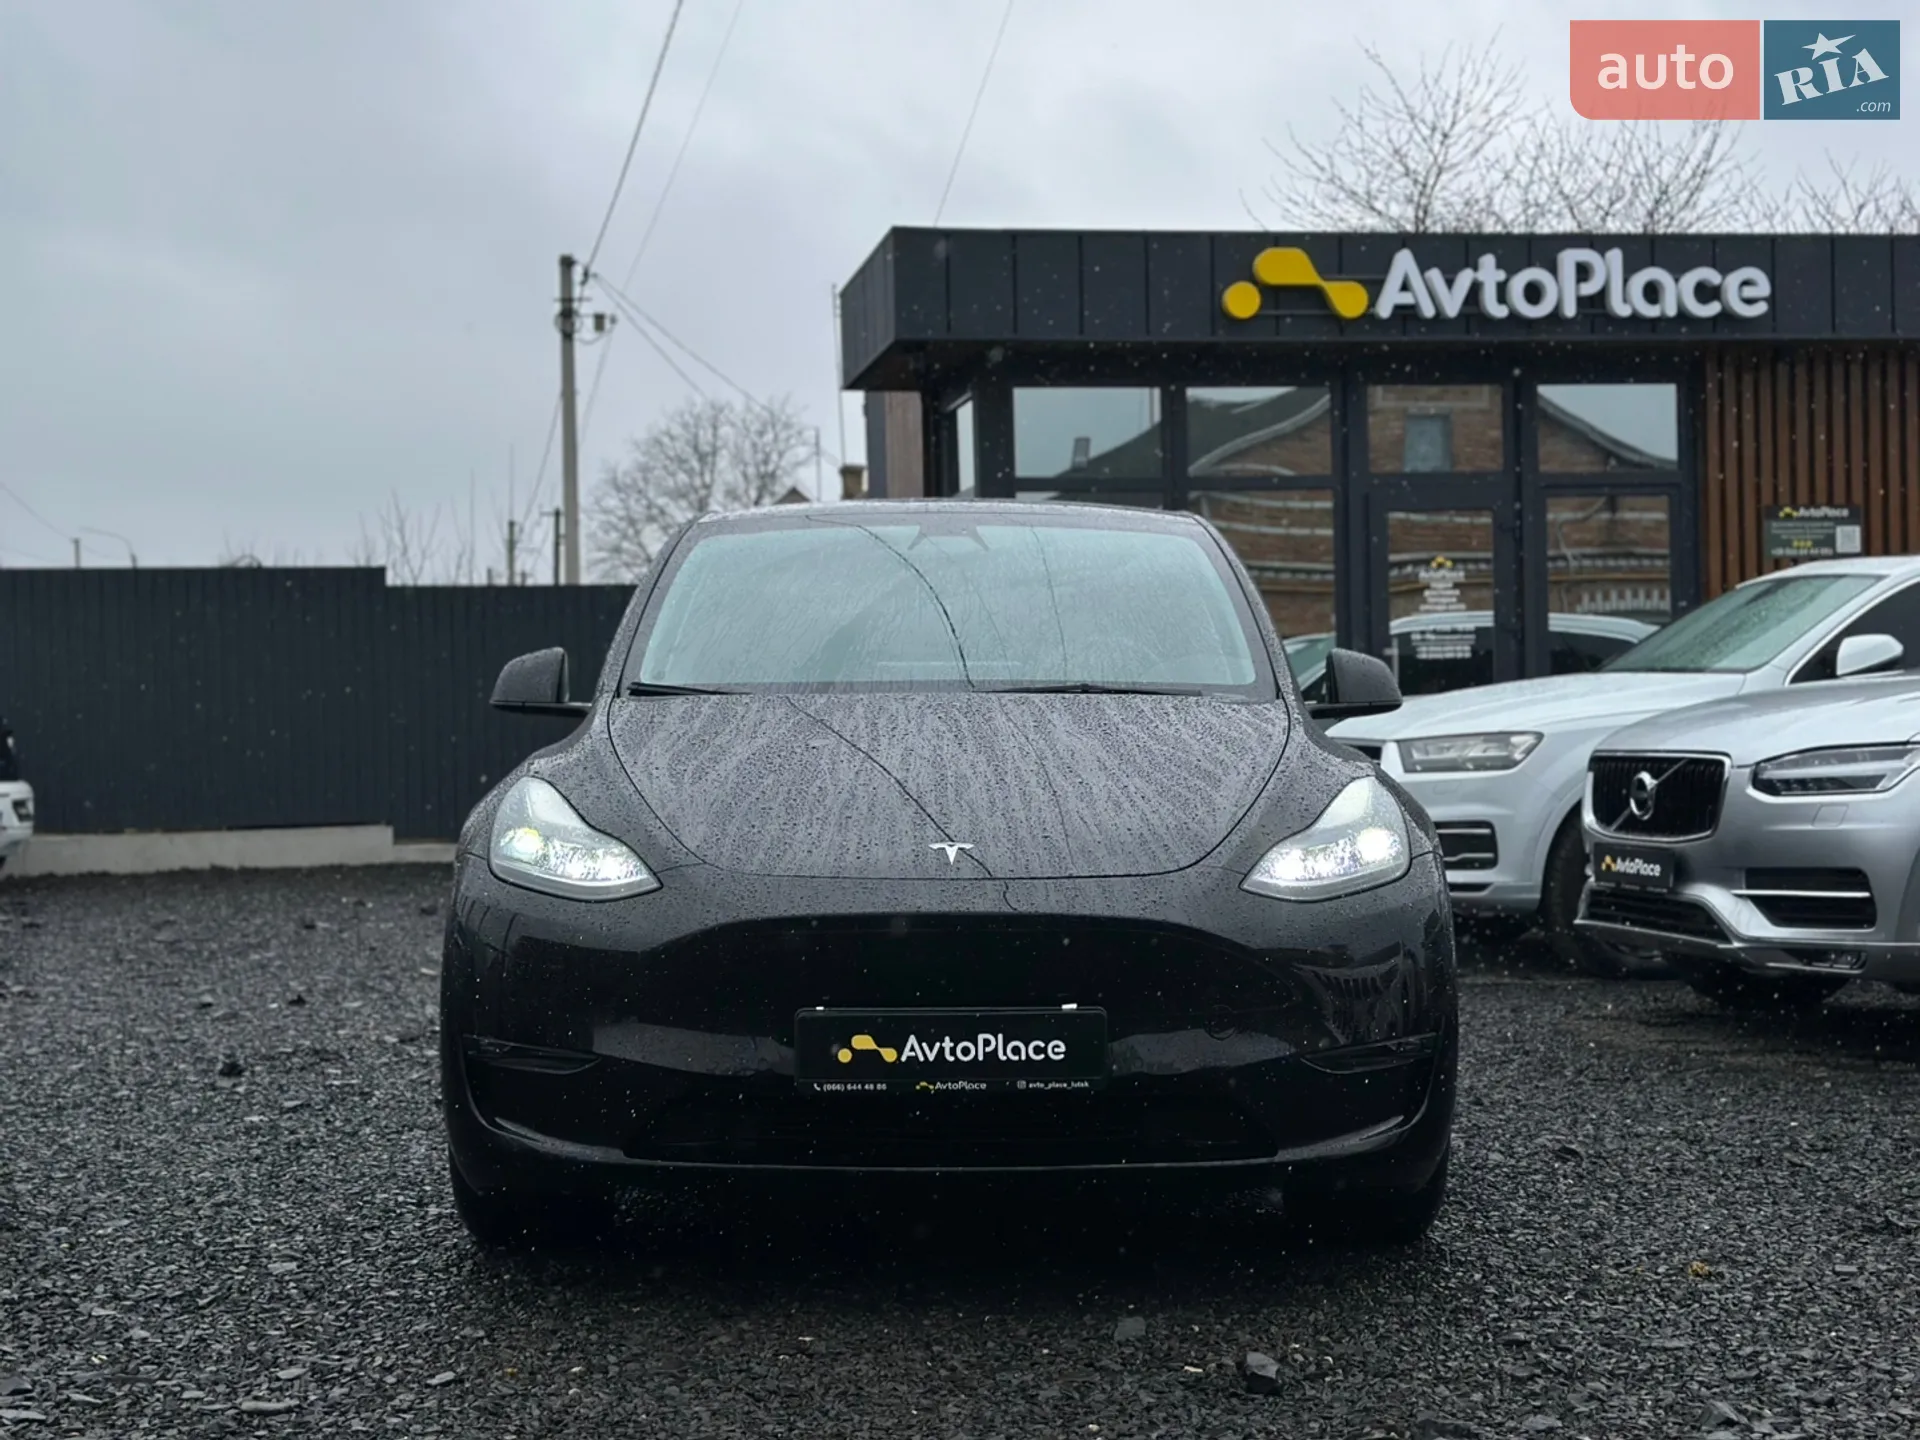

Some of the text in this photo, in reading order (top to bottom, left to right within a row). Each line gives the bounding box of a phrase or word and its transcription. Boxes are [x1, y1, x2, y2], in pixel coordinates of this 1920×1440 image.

[1373, 247, 1772, 320] AvtoPlace
[1616, 857, 1661, 876] AvtoPlace
[900, 1033, 1066, 1062] AvtoPlace
[935, 1081, 987, 1090] AvtoPlace
